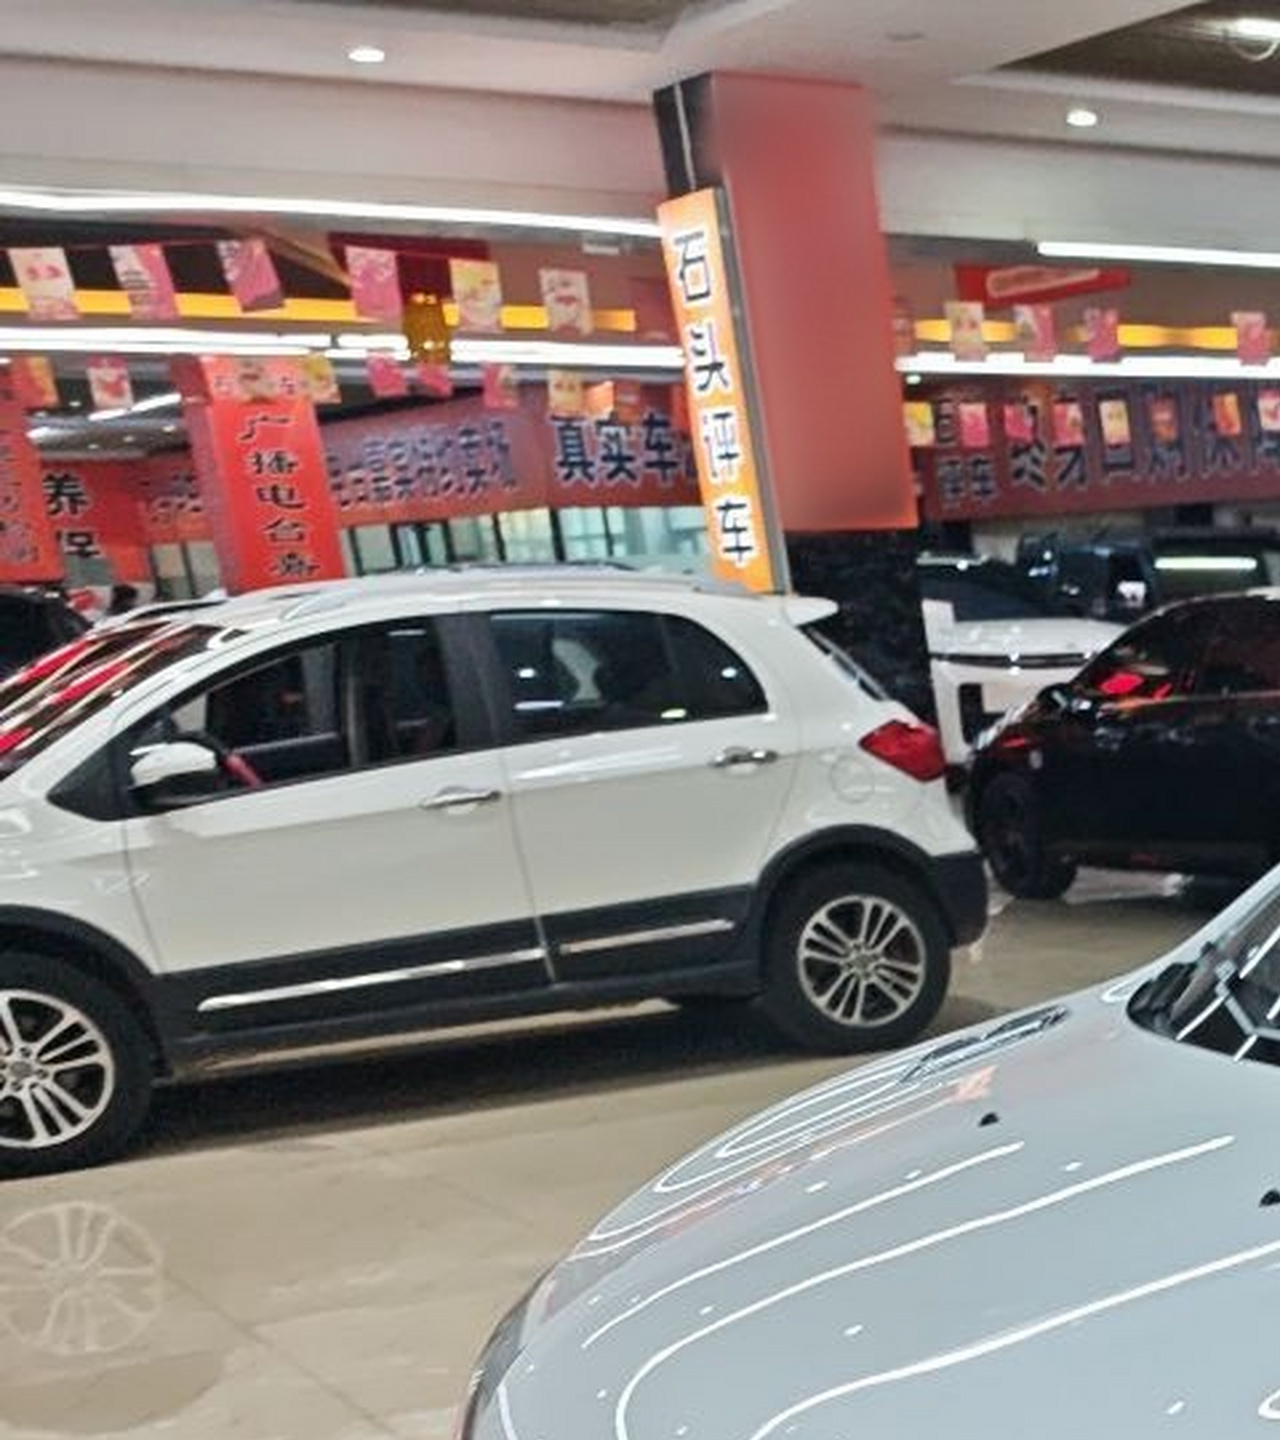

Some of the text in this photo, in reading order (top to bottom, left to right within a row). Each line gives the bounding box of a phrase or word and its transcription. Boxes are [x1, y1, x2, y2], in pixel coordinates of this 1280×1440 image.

[550, 410, 699, 483] 真实车
[674, 230, 753, 565] 石头评车
